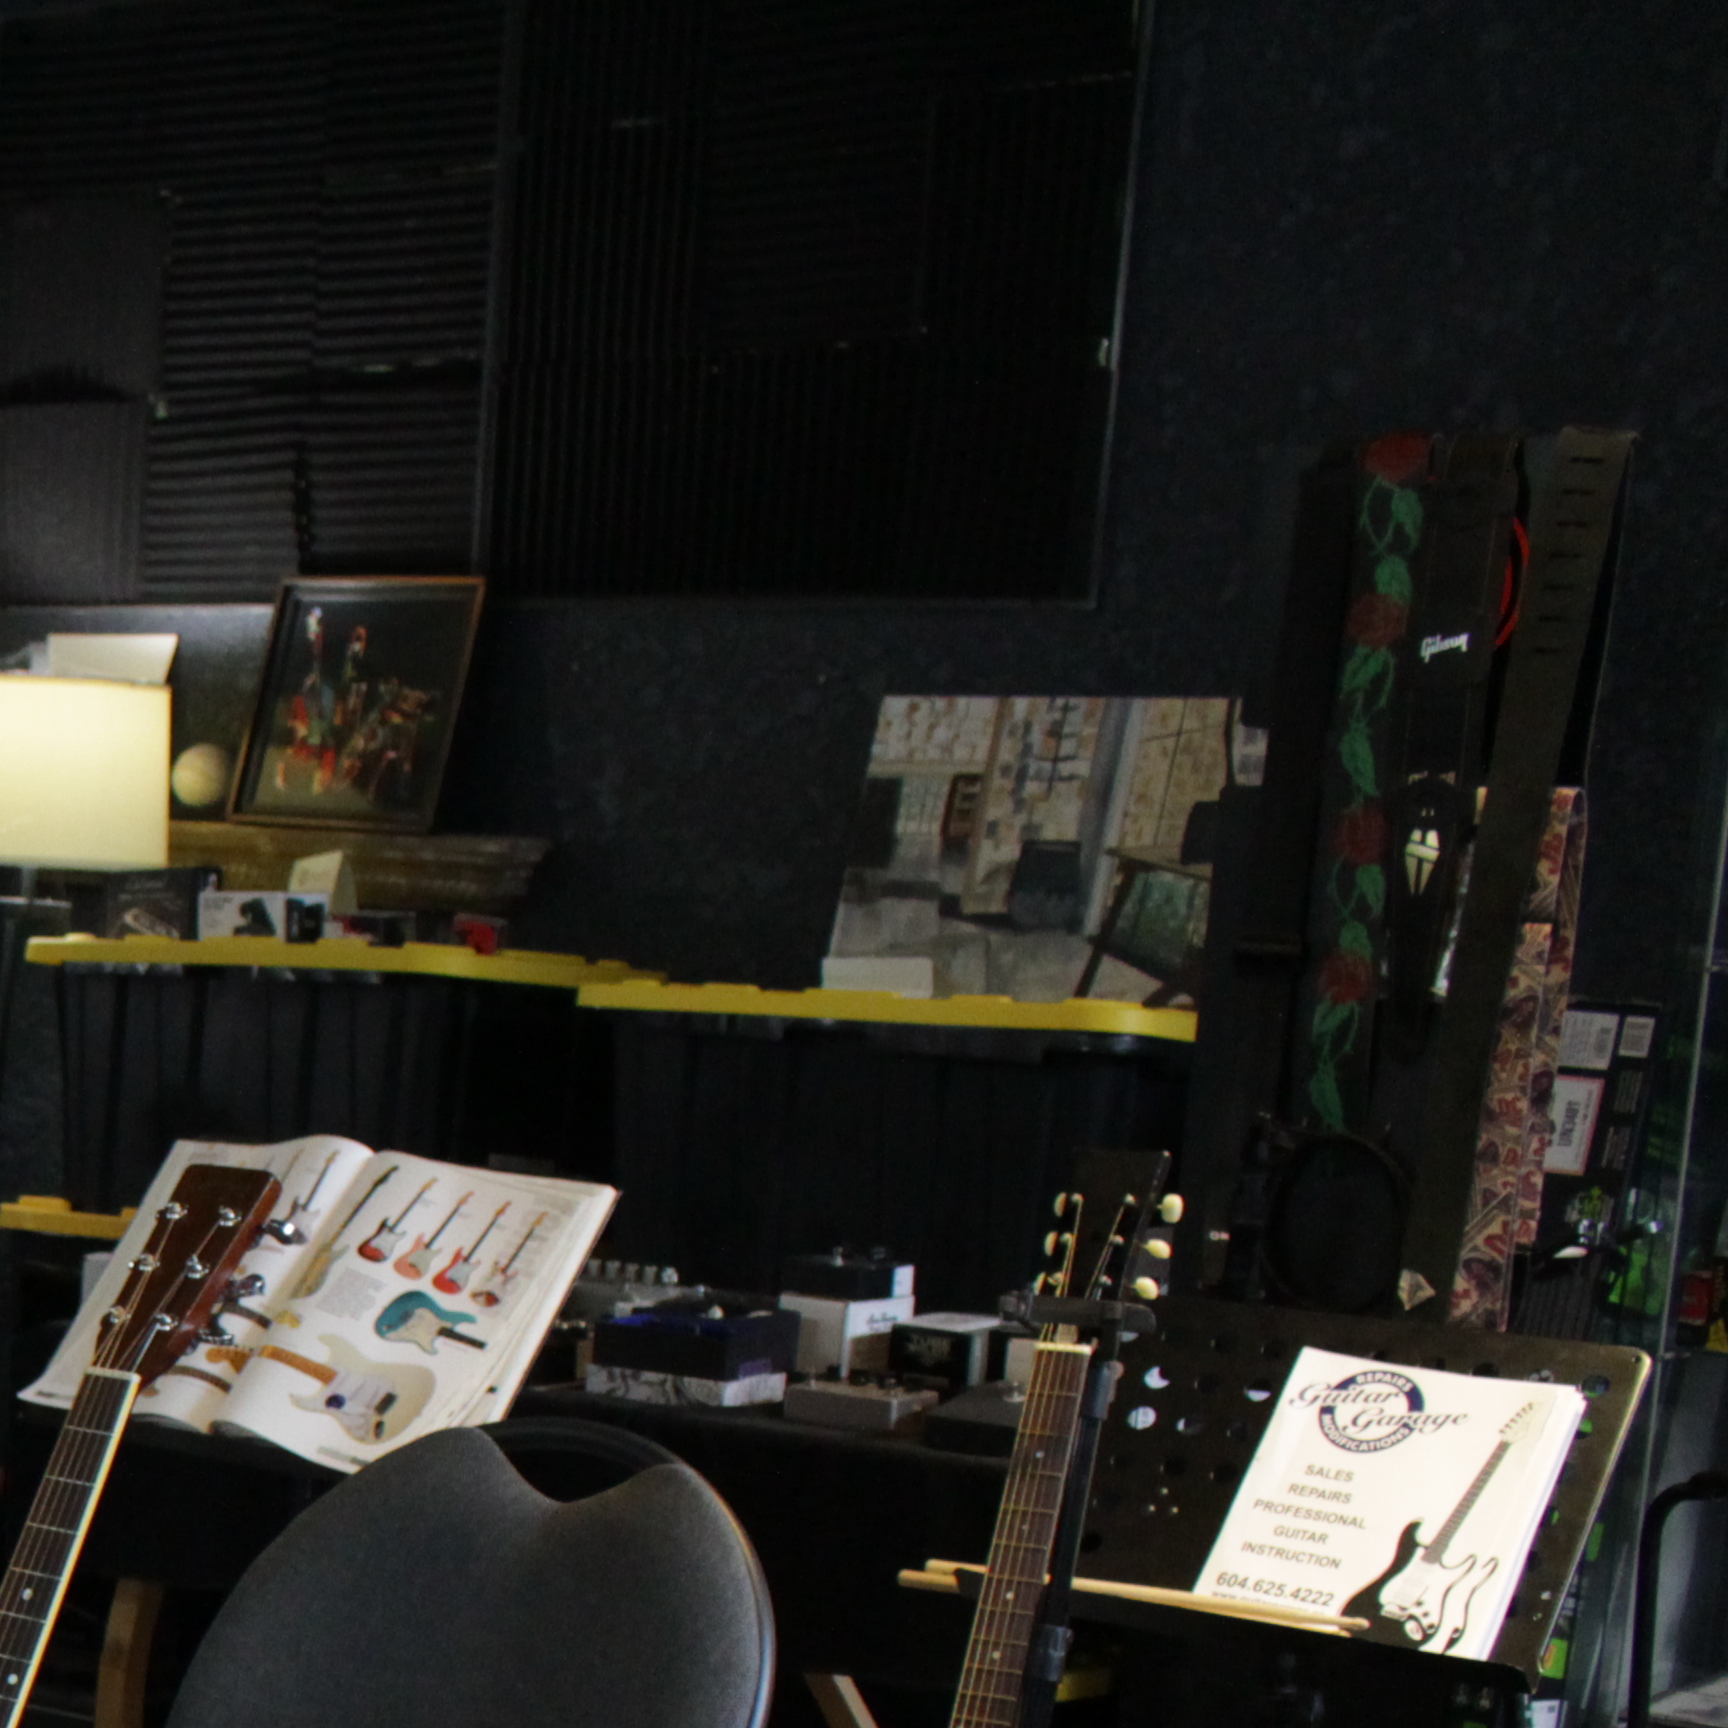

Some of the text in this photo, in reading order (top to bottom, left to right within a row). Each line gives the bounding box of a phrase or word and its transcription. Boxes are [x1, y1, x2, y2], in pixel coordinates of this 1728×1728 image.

[1420, 632, 1470, 663] Gibson
[1289, 1382, 1400, 1409] Guitar
[1355, 1370, 1413, 1393] REPAIRS
[1321, 1411, 1412, 1453] MODIFICATIONS
[1341, 1407, 1469, 1435] Garage
[1304, 1464, 1355, 1482] SALES
[1287, 1483, 1353, 1504] REPAIRS
[1252, 1498, 1367, 1530] PROFESSIONAL
[1273, 1525, 1329, 1544] GUITAR
[1240, 1541, 1342, 1570] INSTRUCTION
[1215, 1571, 1335, 1608] 604.625.4222
